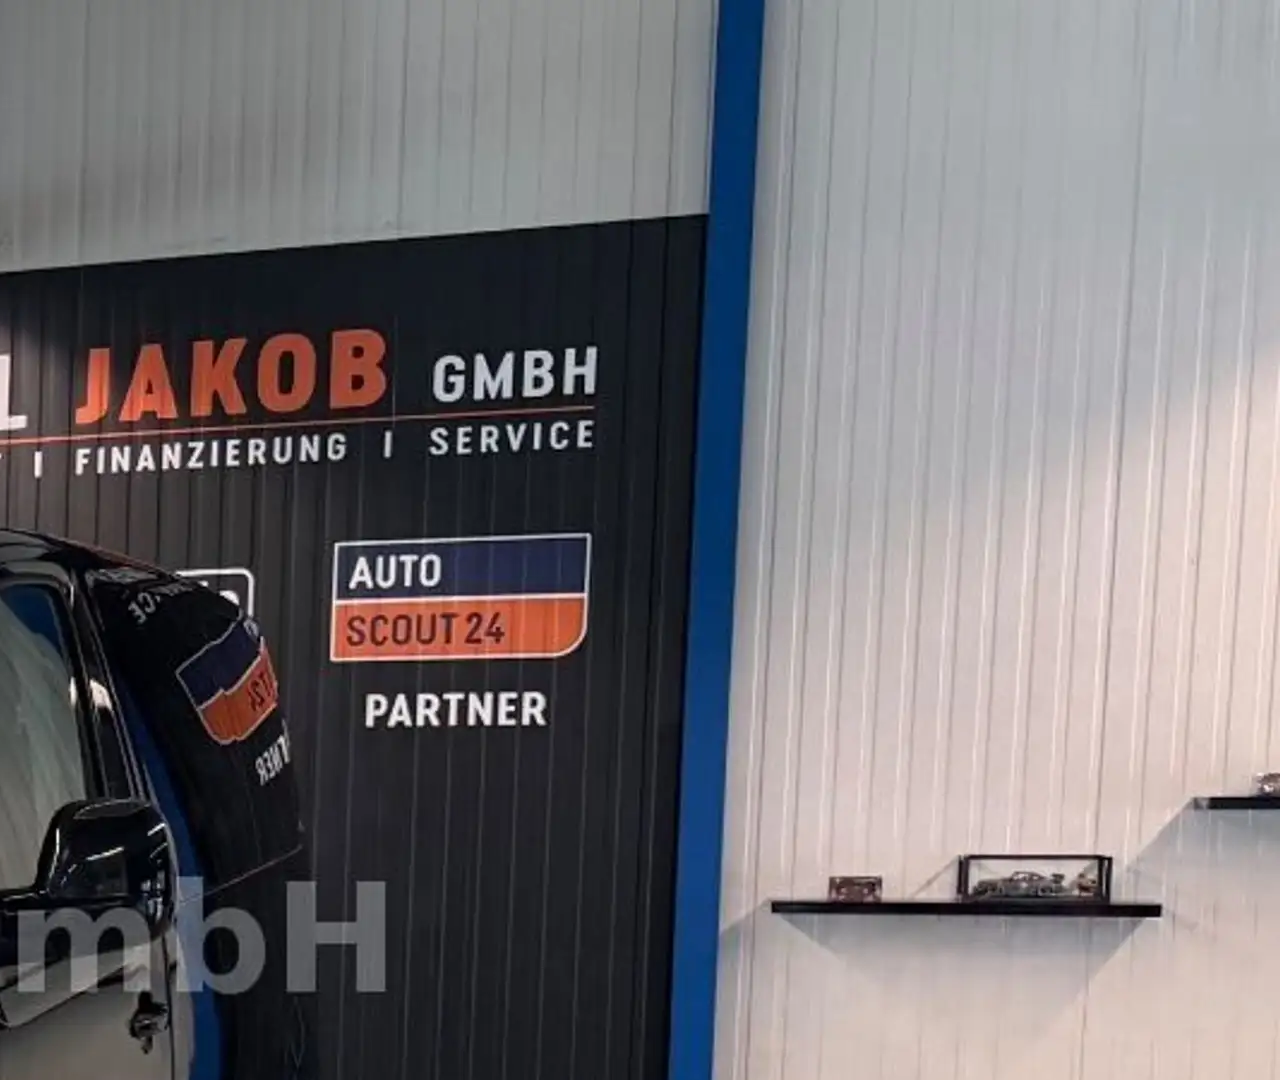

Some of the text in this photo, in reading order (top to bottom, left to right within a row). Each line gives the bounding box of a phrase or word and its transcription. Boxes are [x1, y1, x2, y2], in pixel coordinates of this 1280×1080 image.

[74, 328, 388, 425] JAKOB
[432, 345, 598, 403] GMBH
[75, 432, 348, 476] FINANZIERUNG
[428, 419, 596, 456] SERVICE
[348, 553, 443, 590] AUTO
[364, 691, 548, 729] PARTNER
